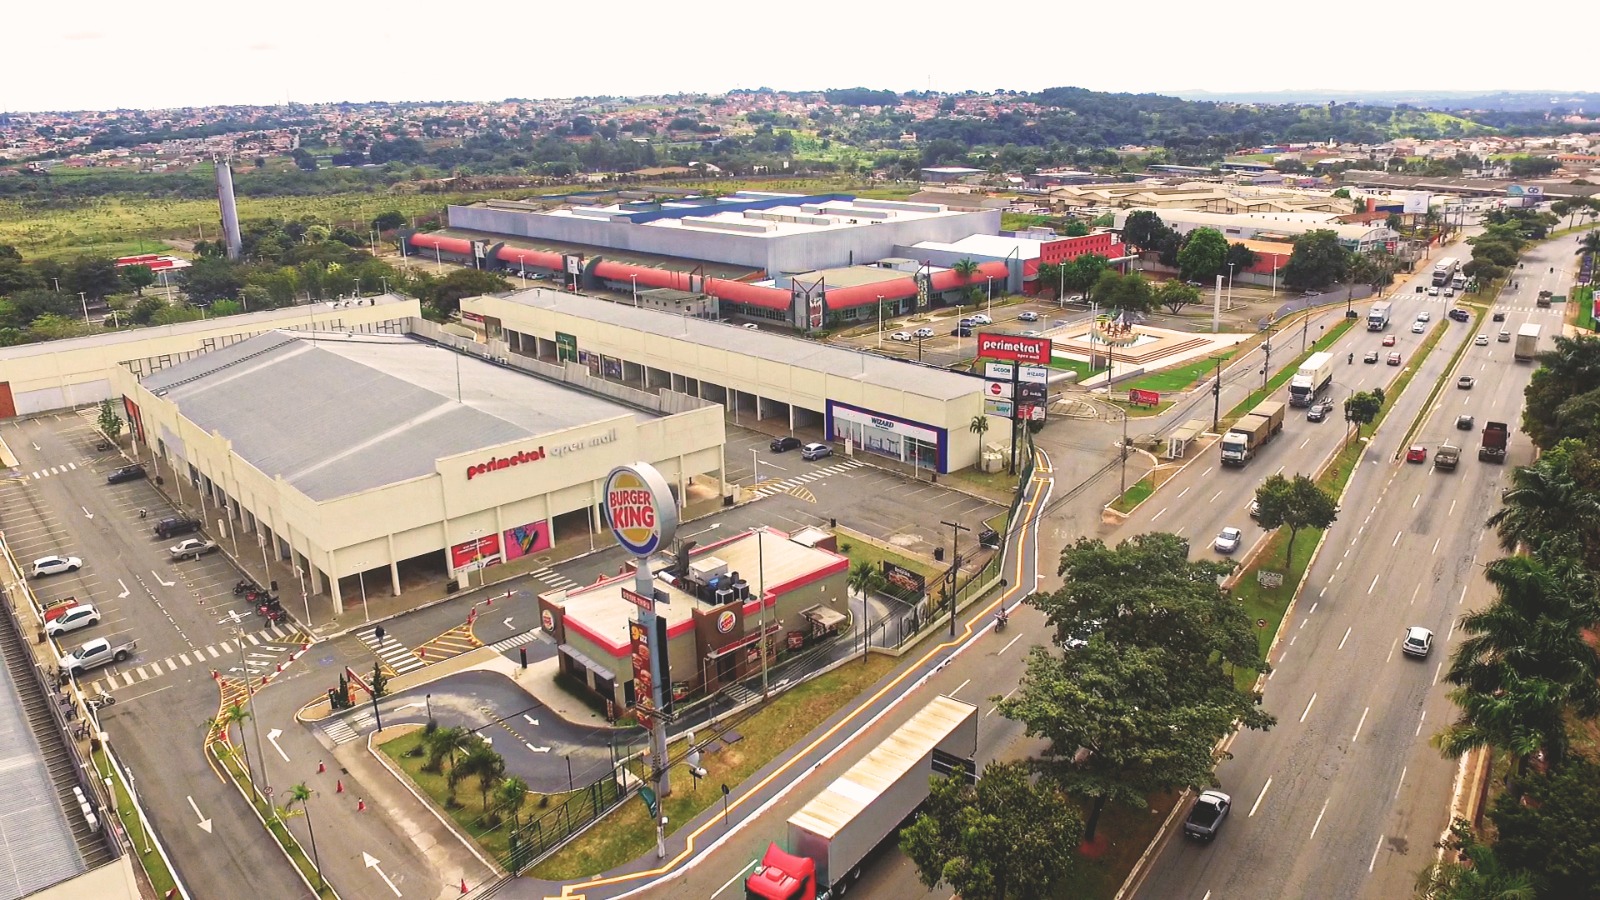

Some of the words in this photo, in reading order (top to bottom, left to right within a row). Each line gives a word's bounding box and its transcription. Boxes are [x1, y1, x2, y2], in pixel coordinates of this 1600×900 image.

[983, 340, 1040, 354] perimetral
[871, 417, 894, 428] WIZARD
[467, 446, 546, 480] perimetral
[610, 490, 651, 507] BURGER
[613, 506, 655, 528] KING
